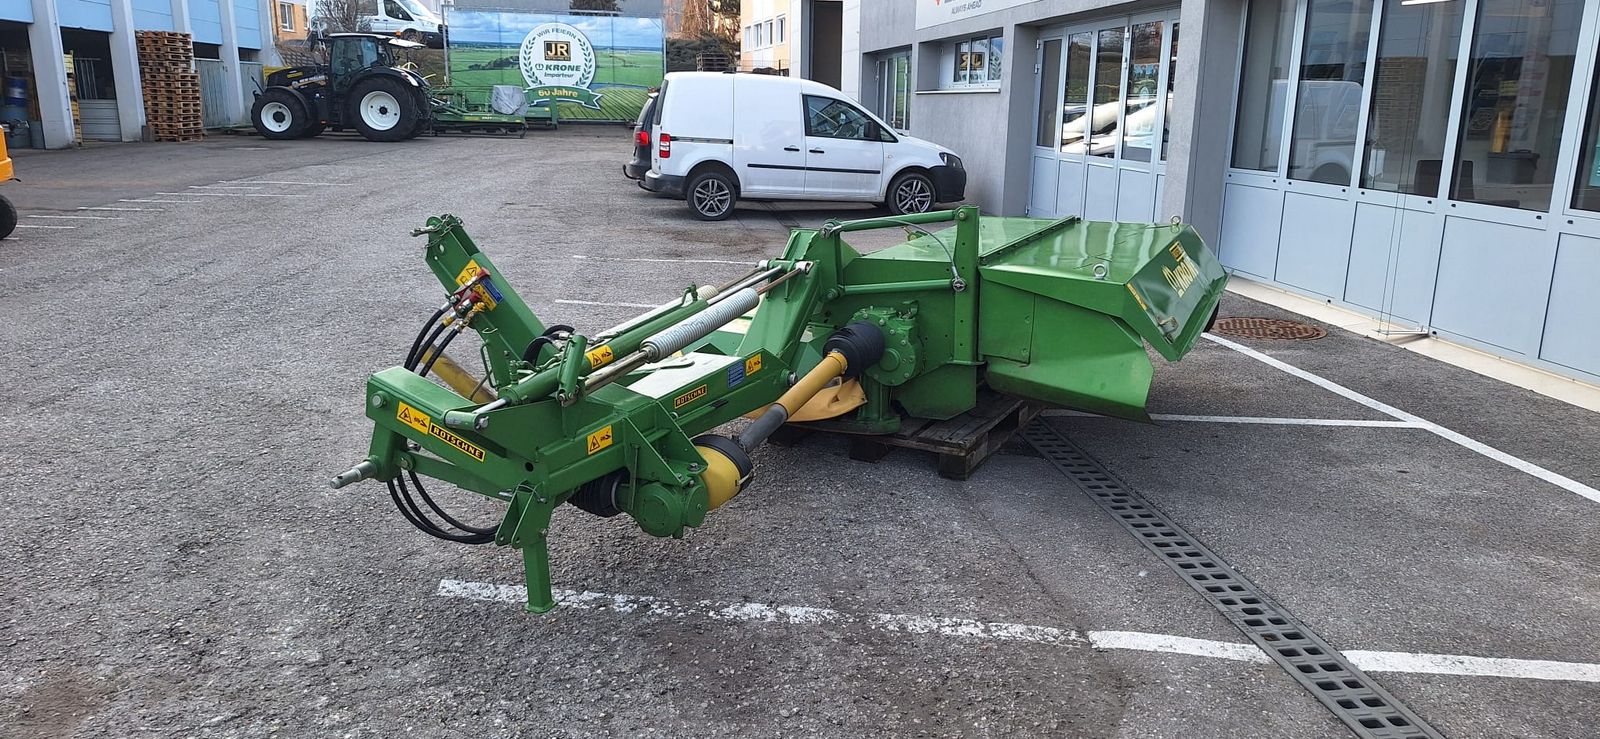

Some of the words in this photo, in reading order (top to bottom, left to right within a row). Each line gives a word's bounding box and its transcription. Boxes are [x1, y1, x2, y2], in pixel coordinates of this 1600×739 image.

[967, 1, 982, 10] AHEAD
[537, 29, 551, 38] WIR
[551, 28, 577, 39] FEIERN
[547, 43, 568, 56] JR
[545, 64, 581, 72] KRONE
[551, 88, 578, 97] Jahre
[677, 387, 705, 406] ROTSCHNE
[433, 426, 481, 458] ROTSCHNE
